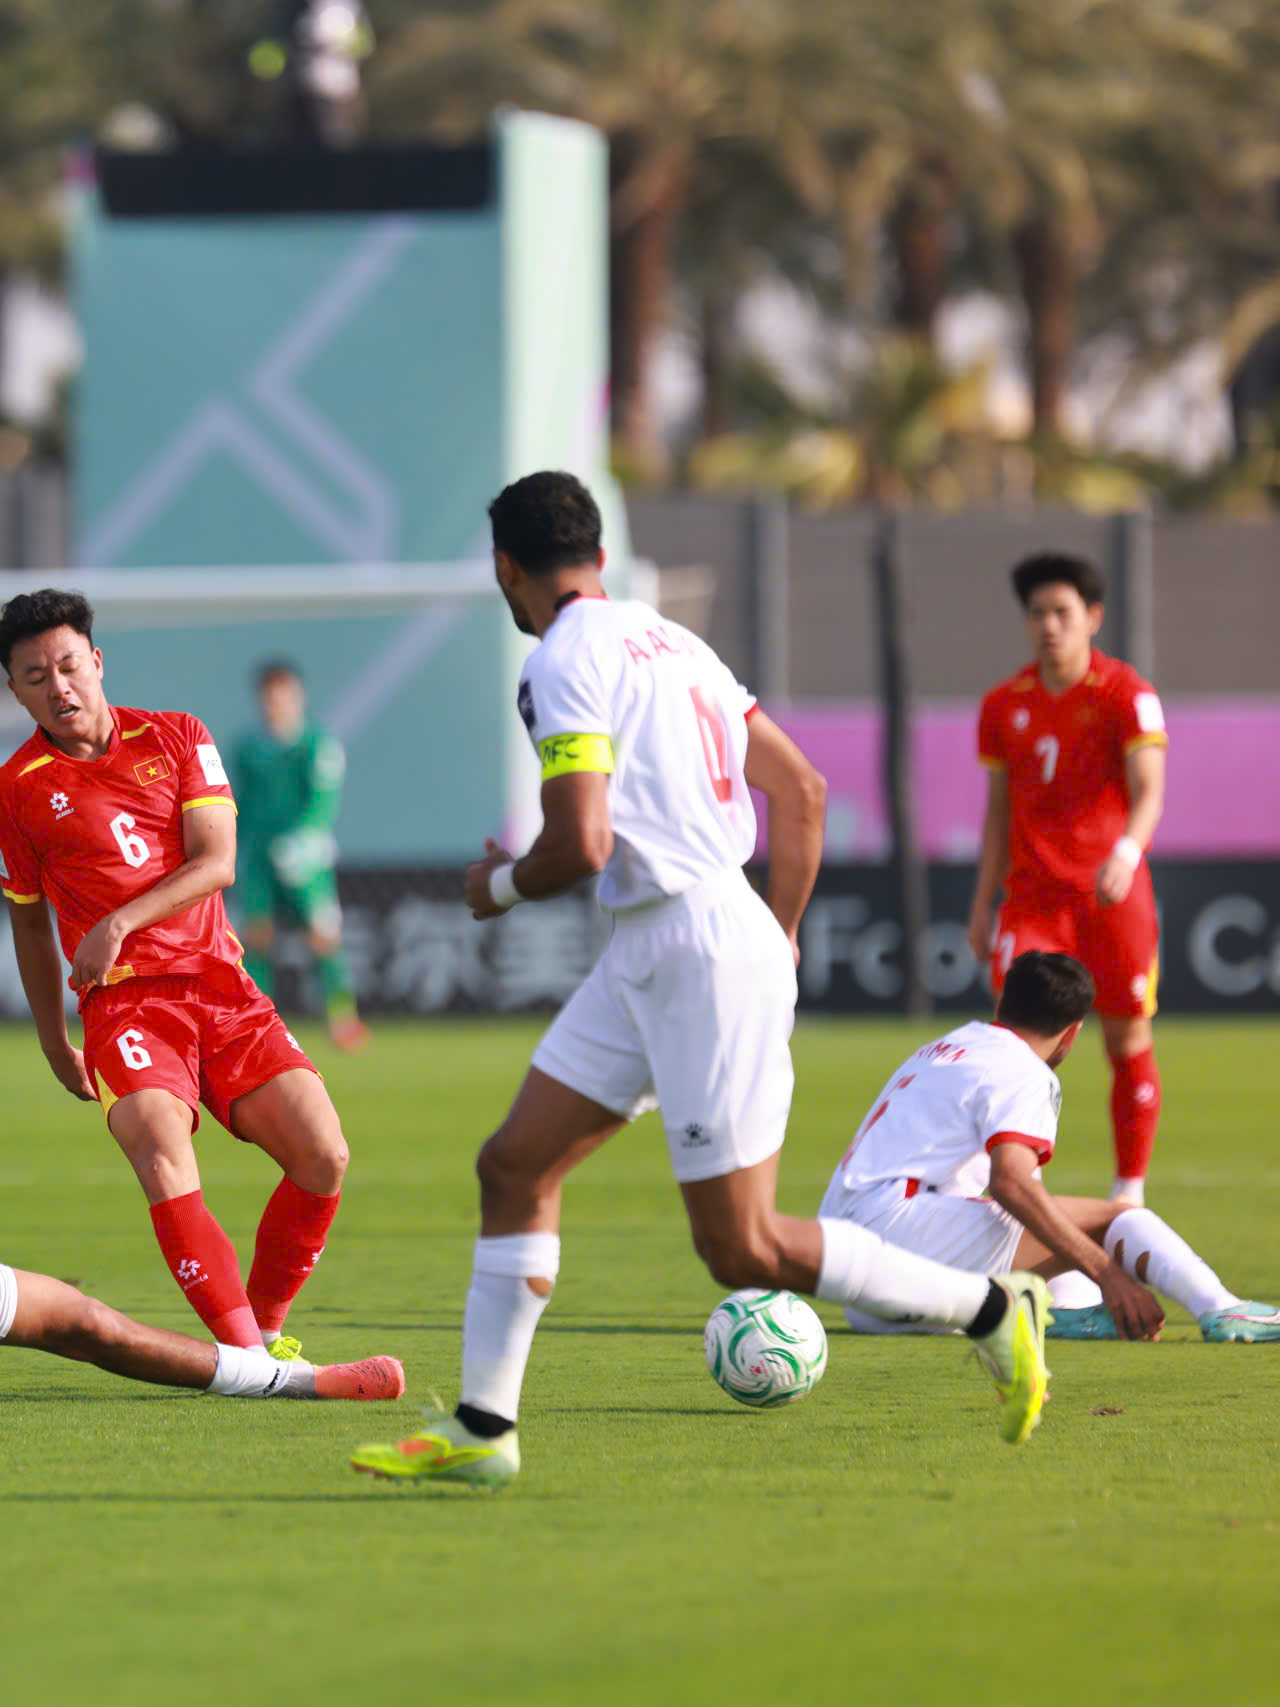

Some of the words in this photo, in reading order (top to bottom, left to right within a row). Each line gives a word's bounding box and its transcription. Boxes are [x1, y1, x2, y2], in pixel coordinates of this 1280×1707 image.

[1033, 734, 1060, 785] 7
[109, 811, 151, 868] 6
[116, 1028, 153, 1071] 6
